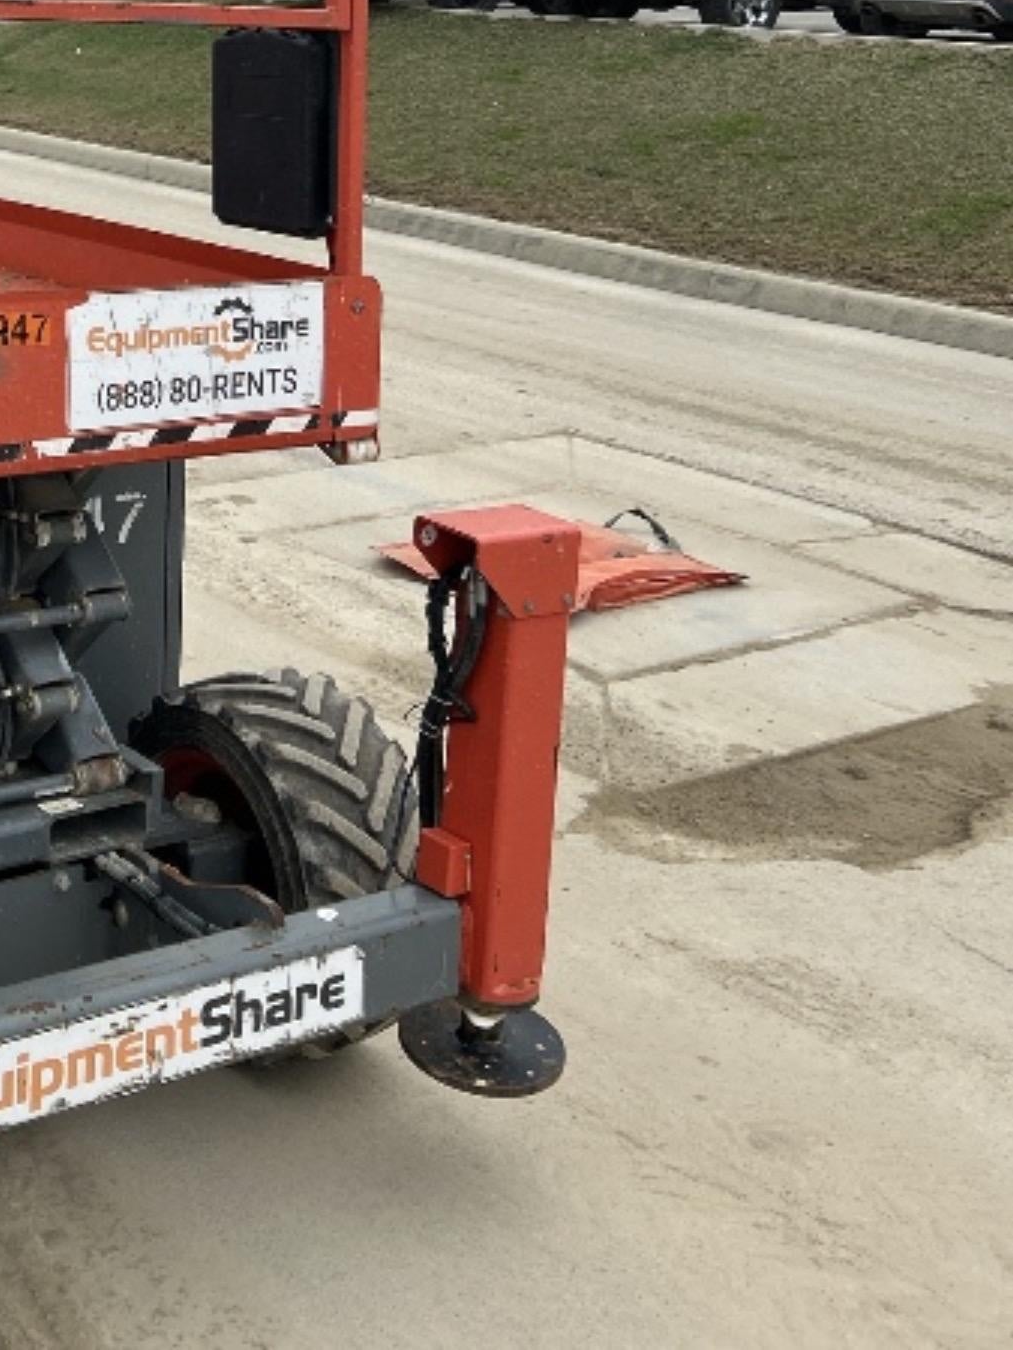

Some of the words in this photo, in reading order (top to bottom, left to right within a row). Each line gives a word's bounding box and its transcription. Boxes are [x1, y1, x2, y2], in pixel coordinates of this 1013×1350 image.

[86, 317, 309, 357] EquipmentShare
[97, 376, 162, 414] (888)
[169, 366, 297, 406] 80-RENTS
